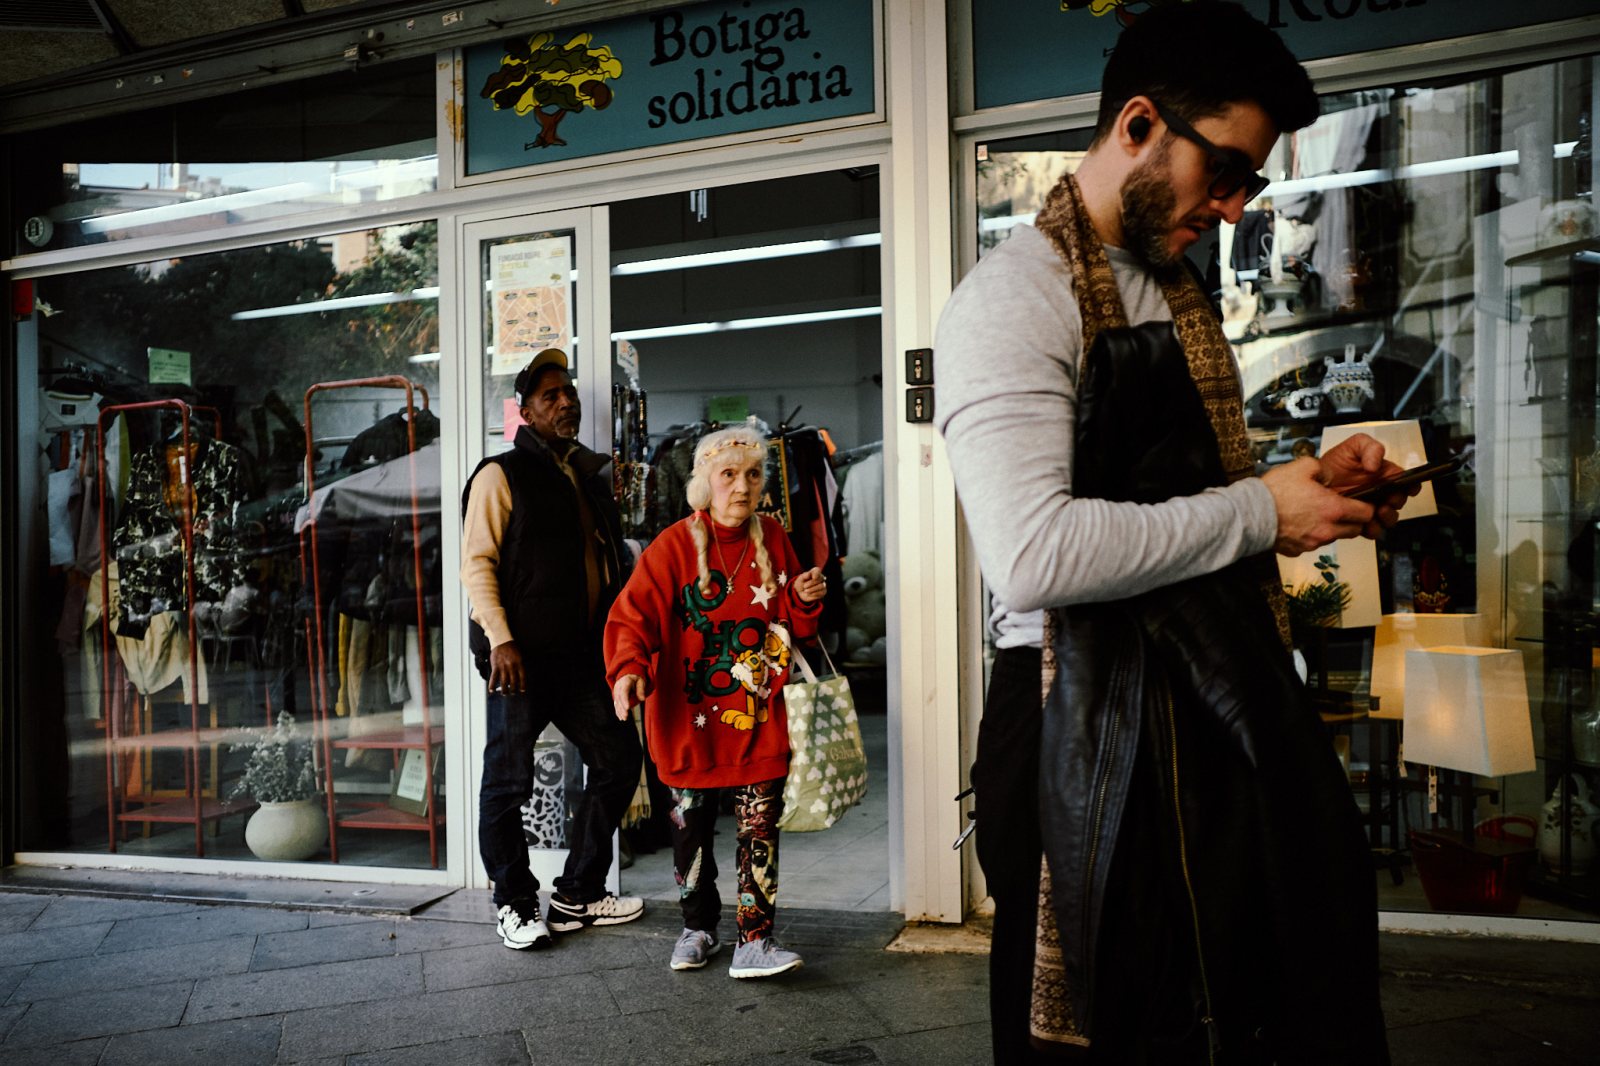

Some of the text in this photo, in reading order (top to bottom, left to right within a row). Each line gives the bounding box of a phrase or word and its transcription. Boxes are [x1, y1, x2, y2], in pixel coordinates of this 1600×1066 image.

[649, 2, 810, 74] Botiga
[647, 52, 852, 128] solidària
[702, 616, 767, 662] HO
[684, 657, 741, 703] HO
